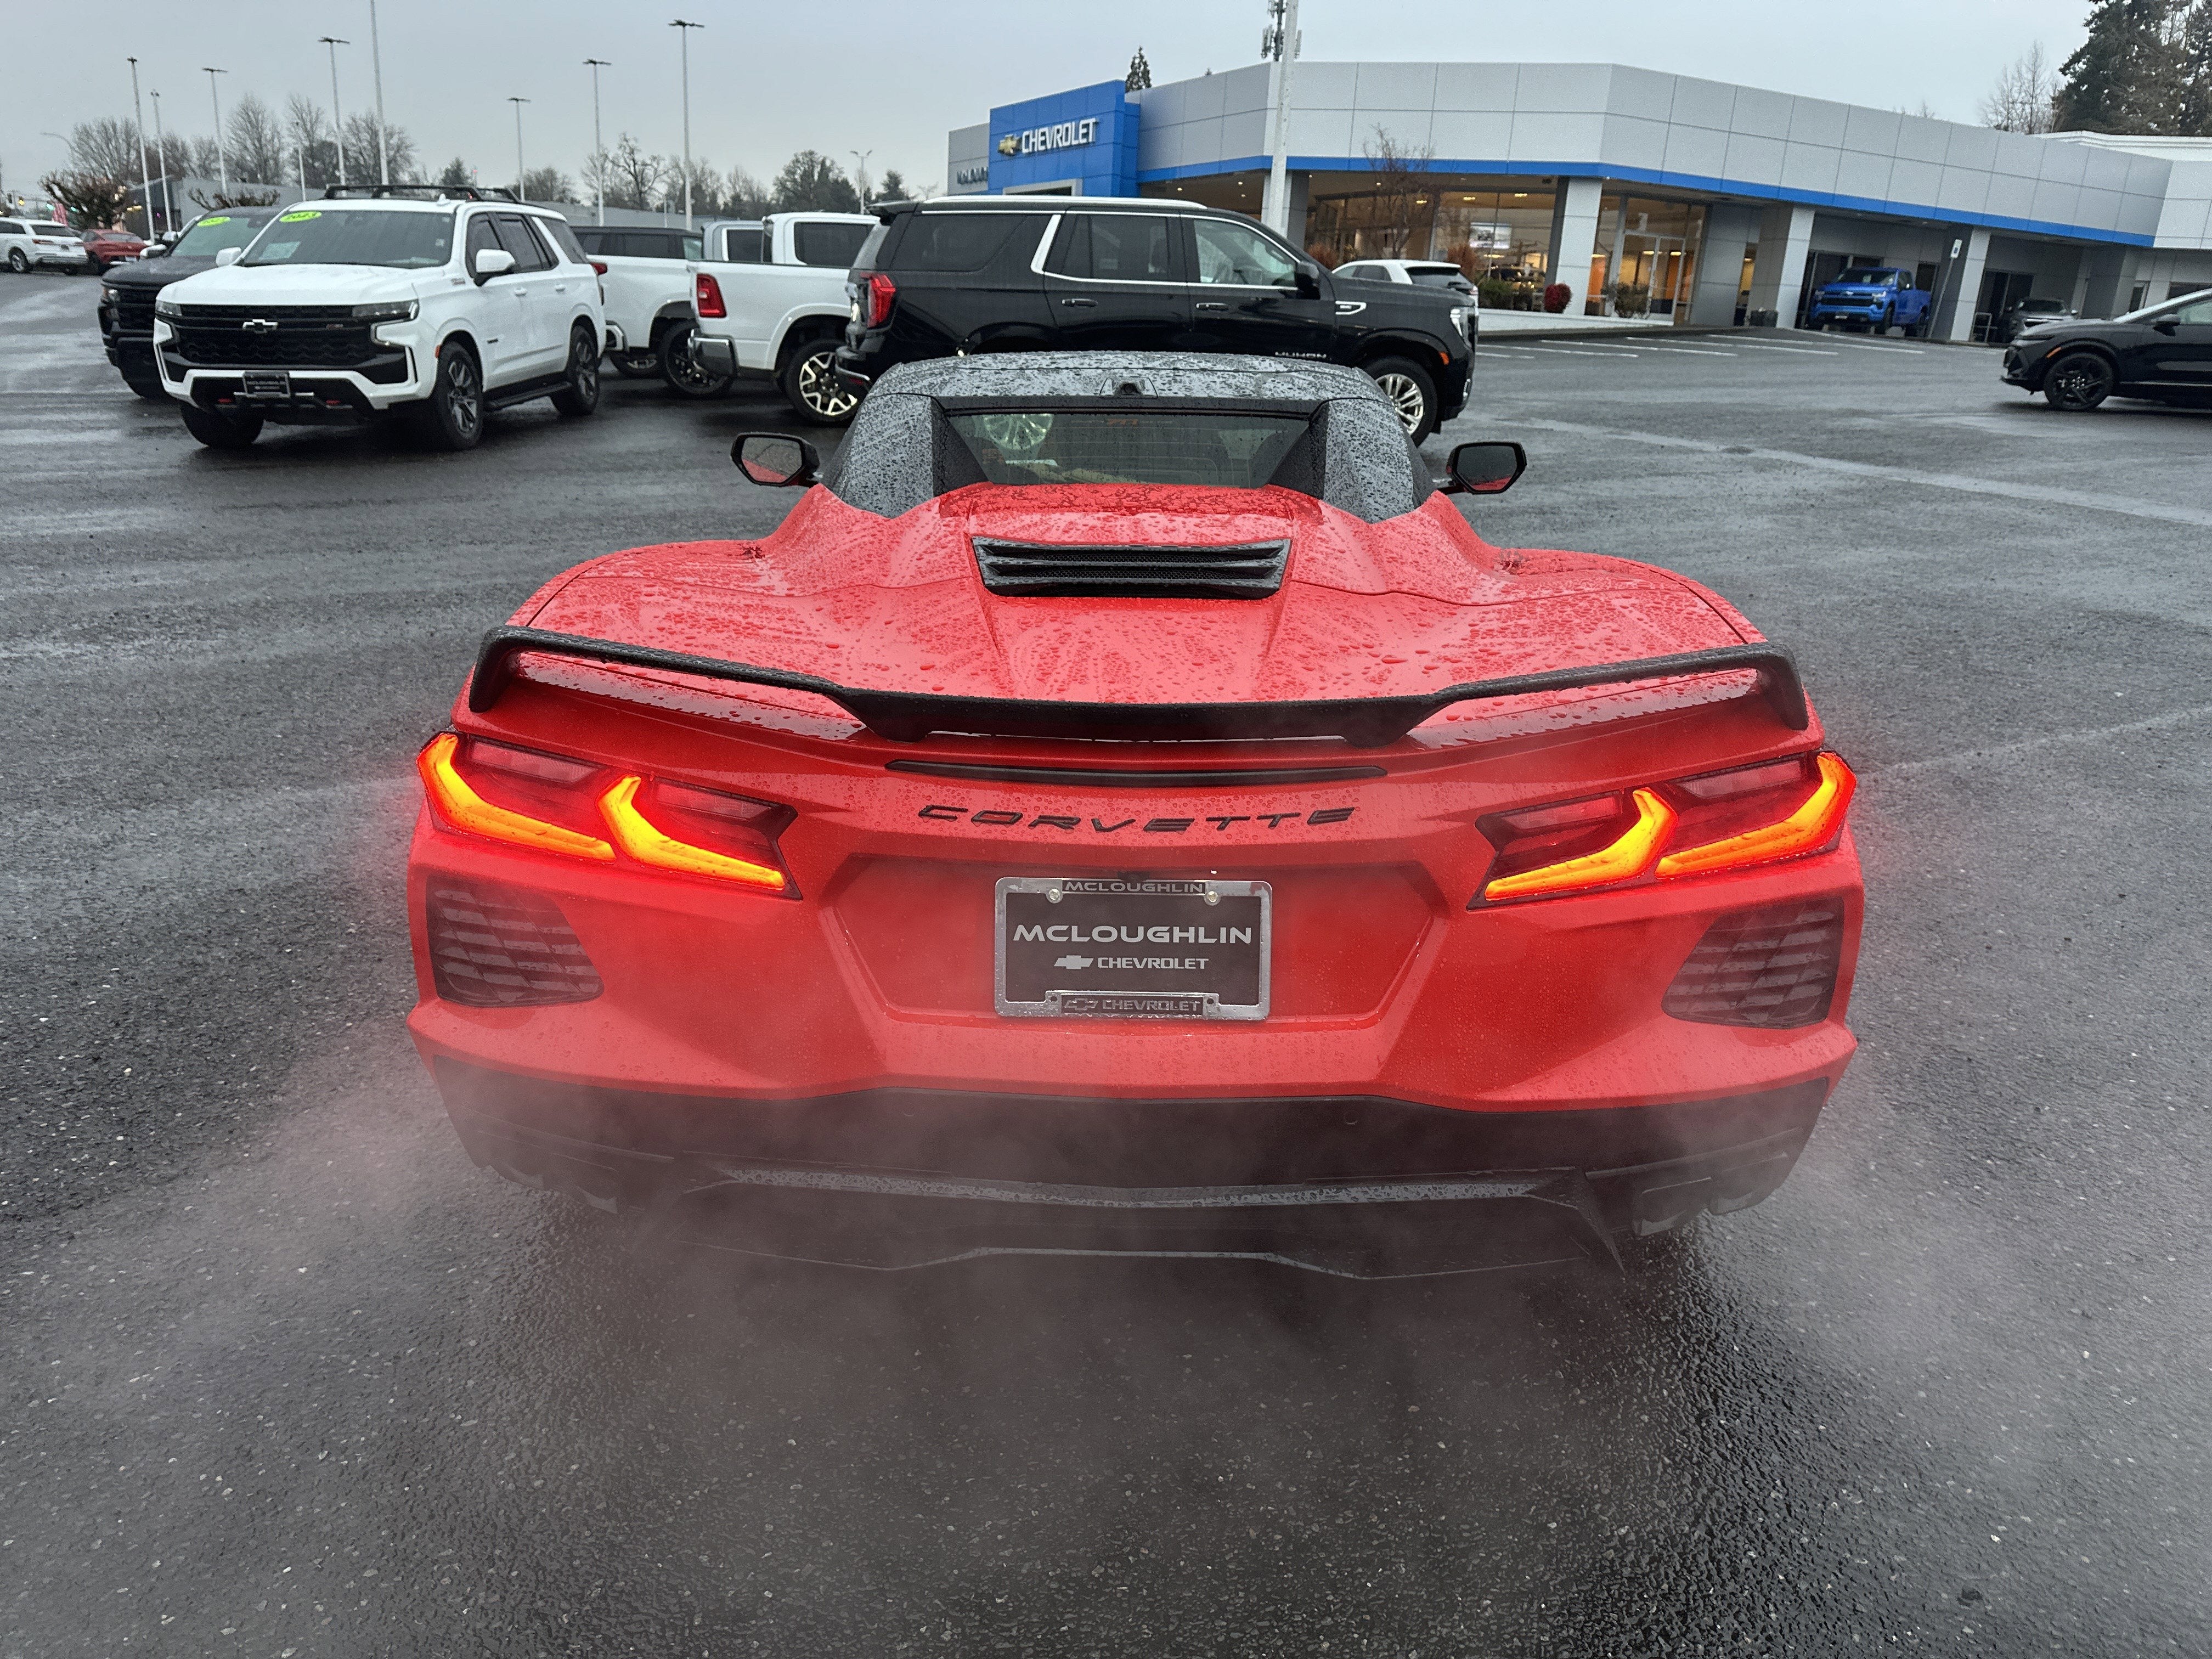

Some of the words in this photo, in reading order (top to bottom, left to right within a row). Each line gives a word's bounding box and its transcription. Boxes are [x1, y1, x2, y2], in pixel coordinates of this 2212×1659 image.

[1022, 118, 1096, 154] CHEVROLET
[918, 804, 1355, 832] CORVETTE
[1065, 882, 1203, 893] MCLOUGHLIN
[1013, 924, 1251, 944] MCLOUGHLIN
[1098, 957, 1209, 969] CHEVROLET
[1102, 1000, 1200, 1011] CHEVROLET
